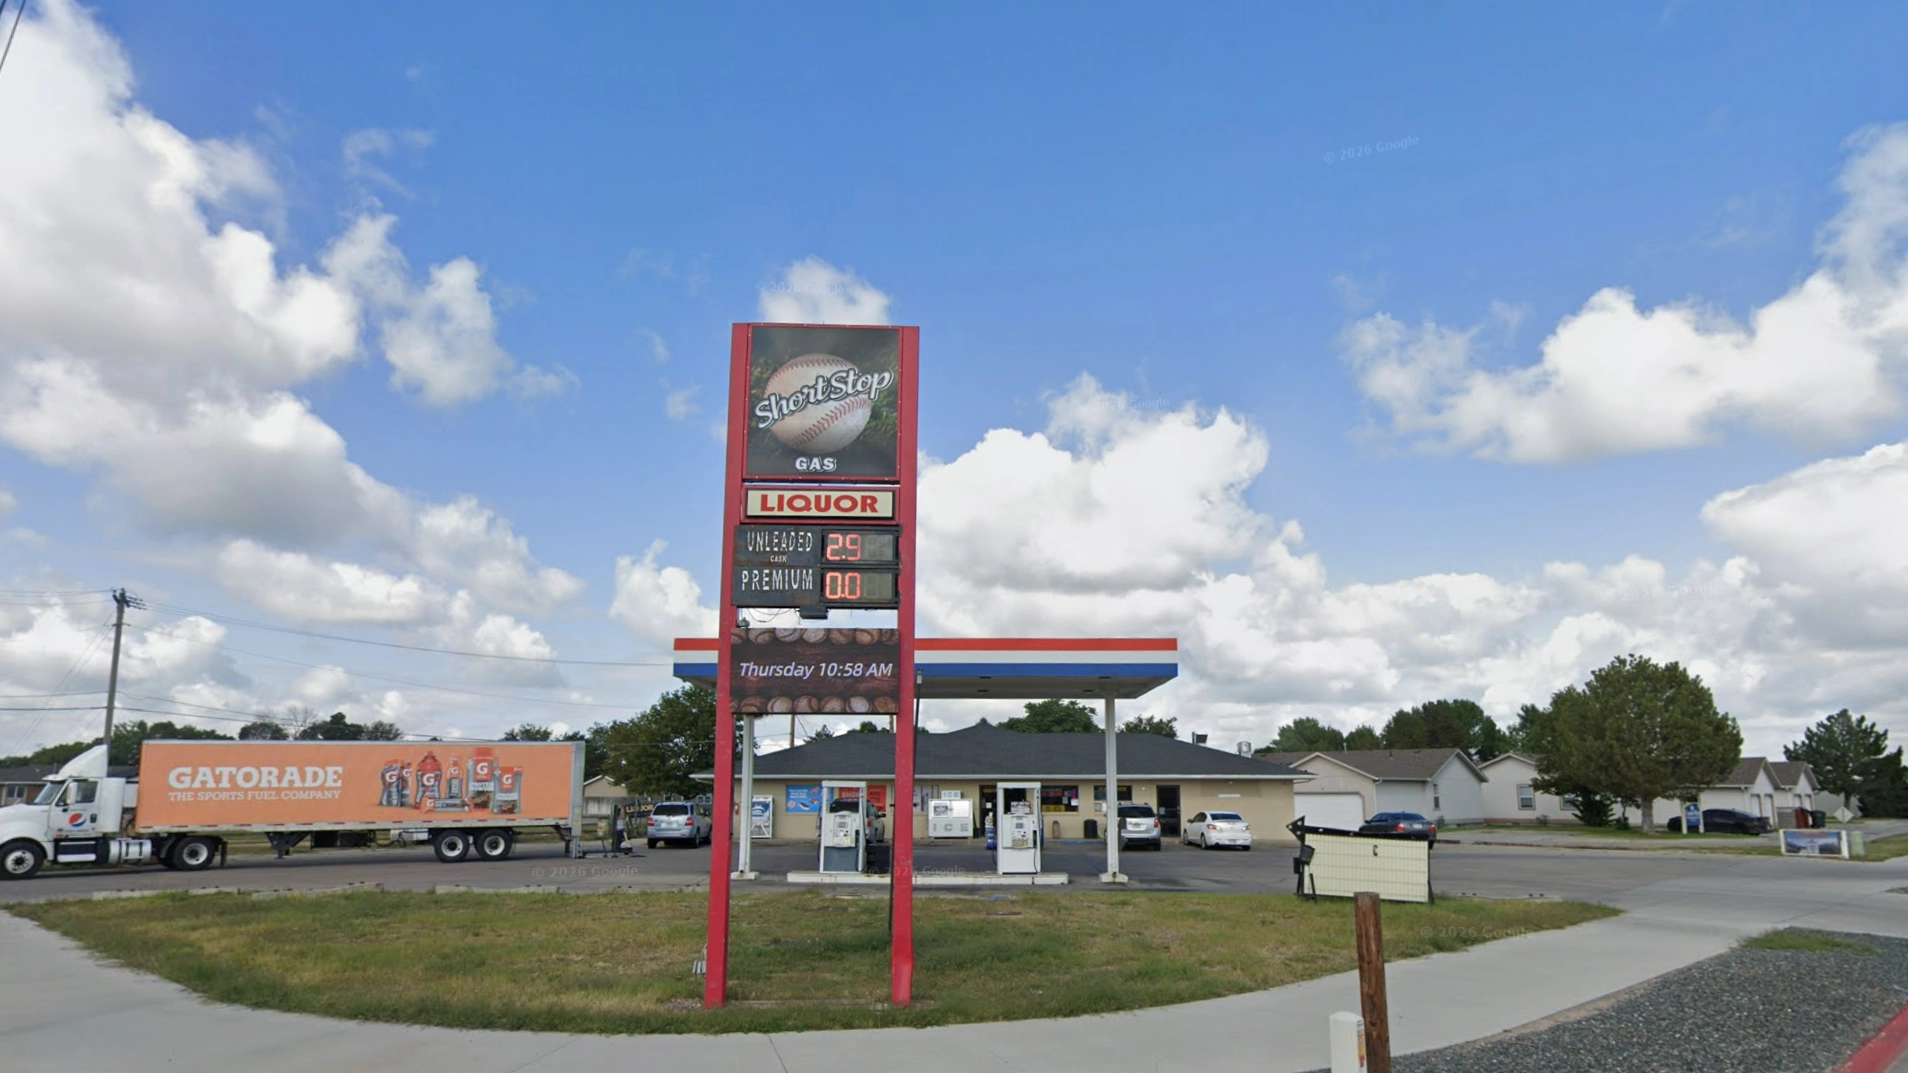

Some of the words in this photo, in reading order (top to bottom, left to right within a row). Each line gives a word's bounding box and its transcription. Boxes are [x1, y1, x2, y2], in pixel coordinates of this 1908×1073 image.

[795, 457, 837, 472] GAS
[760, 494, 879, 513] LIQUOR
[747, 531, 813, 552] UNLEADED
[826, 533, 862, 561] 2.9
[742, 568, 813, 590] PREMIUM
[825, 572, 861, 599] 0.0
[740, 662, 814, 679] Thursday
[819, 663, 862, 677] 10:58
[866, 663, 893, 677] AM
[476, 762, 488, 775] G
[168, 766, 343, 789] GATORADE
[385, 771, 397, 783] G
[423, 773, 435, 786] G
[503, 774, 512, 785] G
[168, 791, 195, 801] THE
[197, 791, 244, 801] SPORTS
[247, 790, 279, 800] FUEL
[281, 790, 342, 800] COMPANY
[933, 823, 969, 832] ICE
